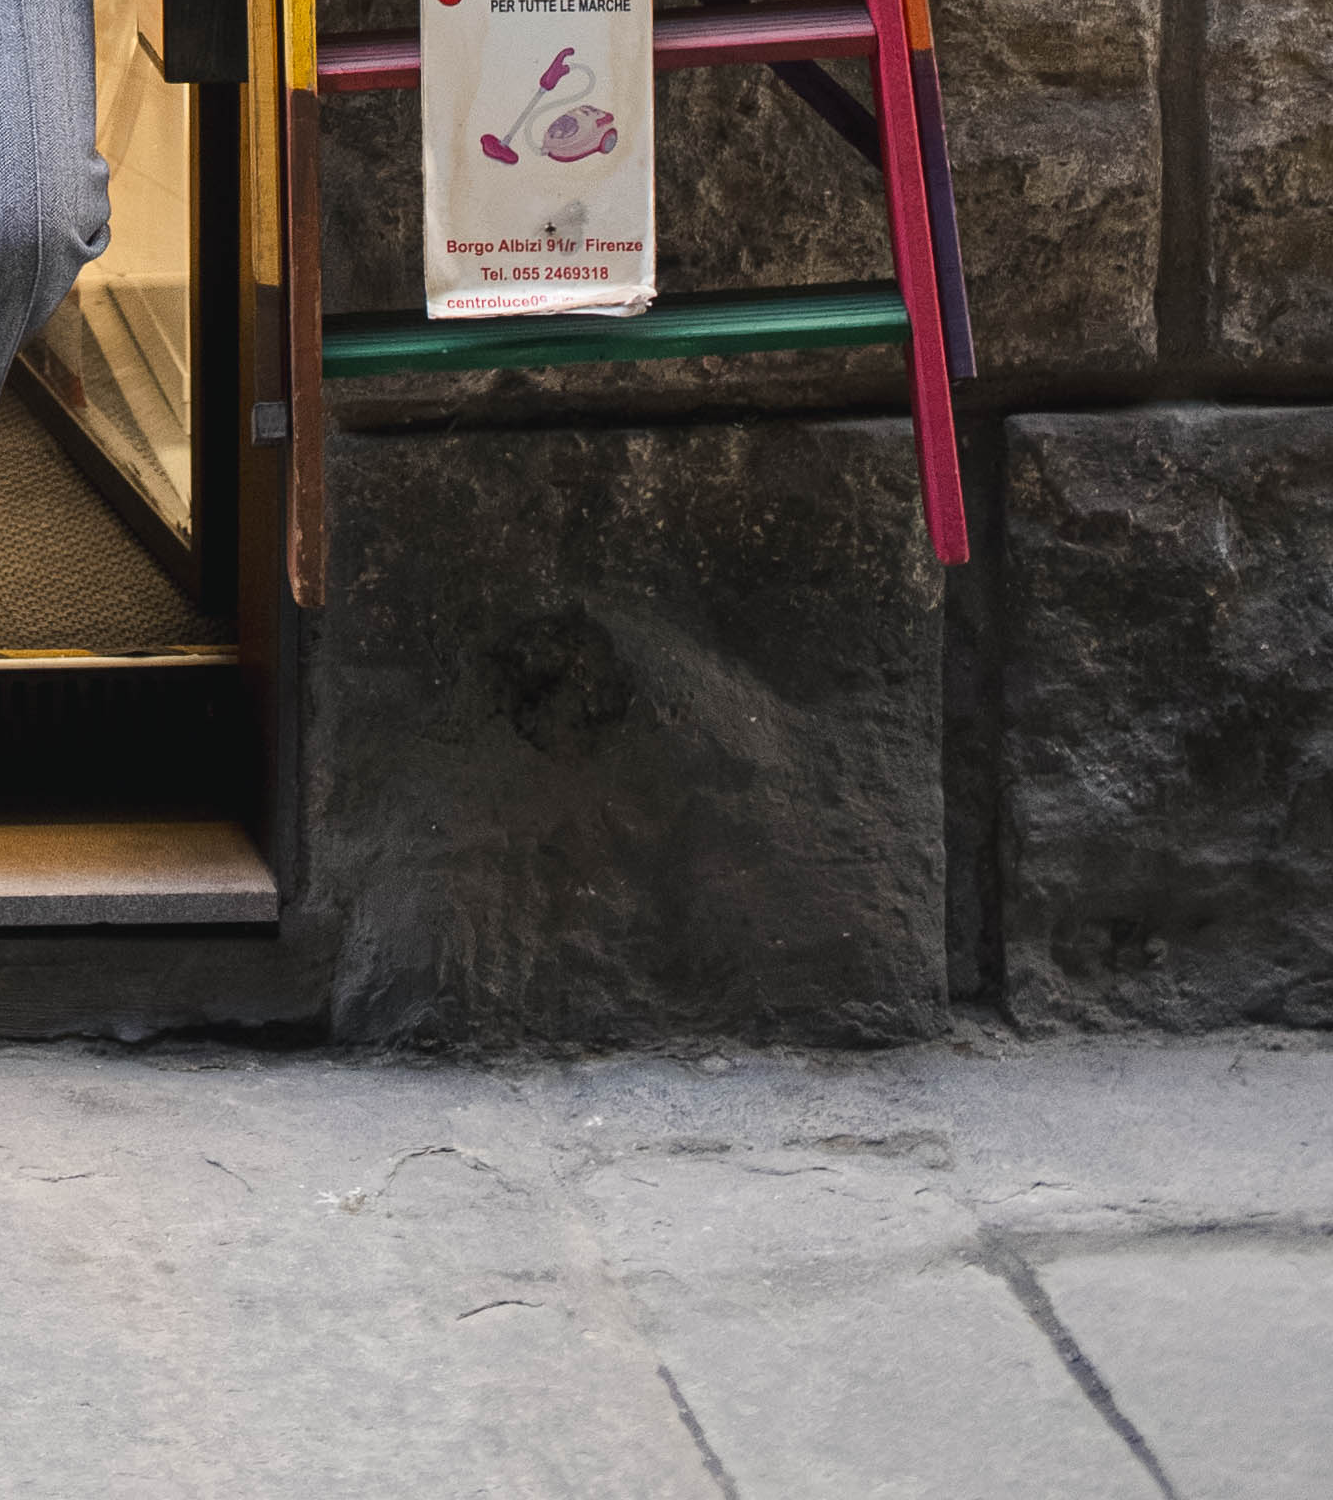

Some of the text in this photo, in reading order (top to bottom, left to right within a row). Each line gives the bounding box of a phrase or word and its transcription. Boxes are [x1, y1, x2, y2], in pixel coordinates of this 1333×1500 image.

[490, 0, 516, 14] PER
[519, 0, 558, 14] TUTTE
[560, 0, 577, 14] LE
[446, 238, 645, 257] Borgo Albizi 91/r Firenze
[480, 266, 611, 282] Tel. 055 2469318
